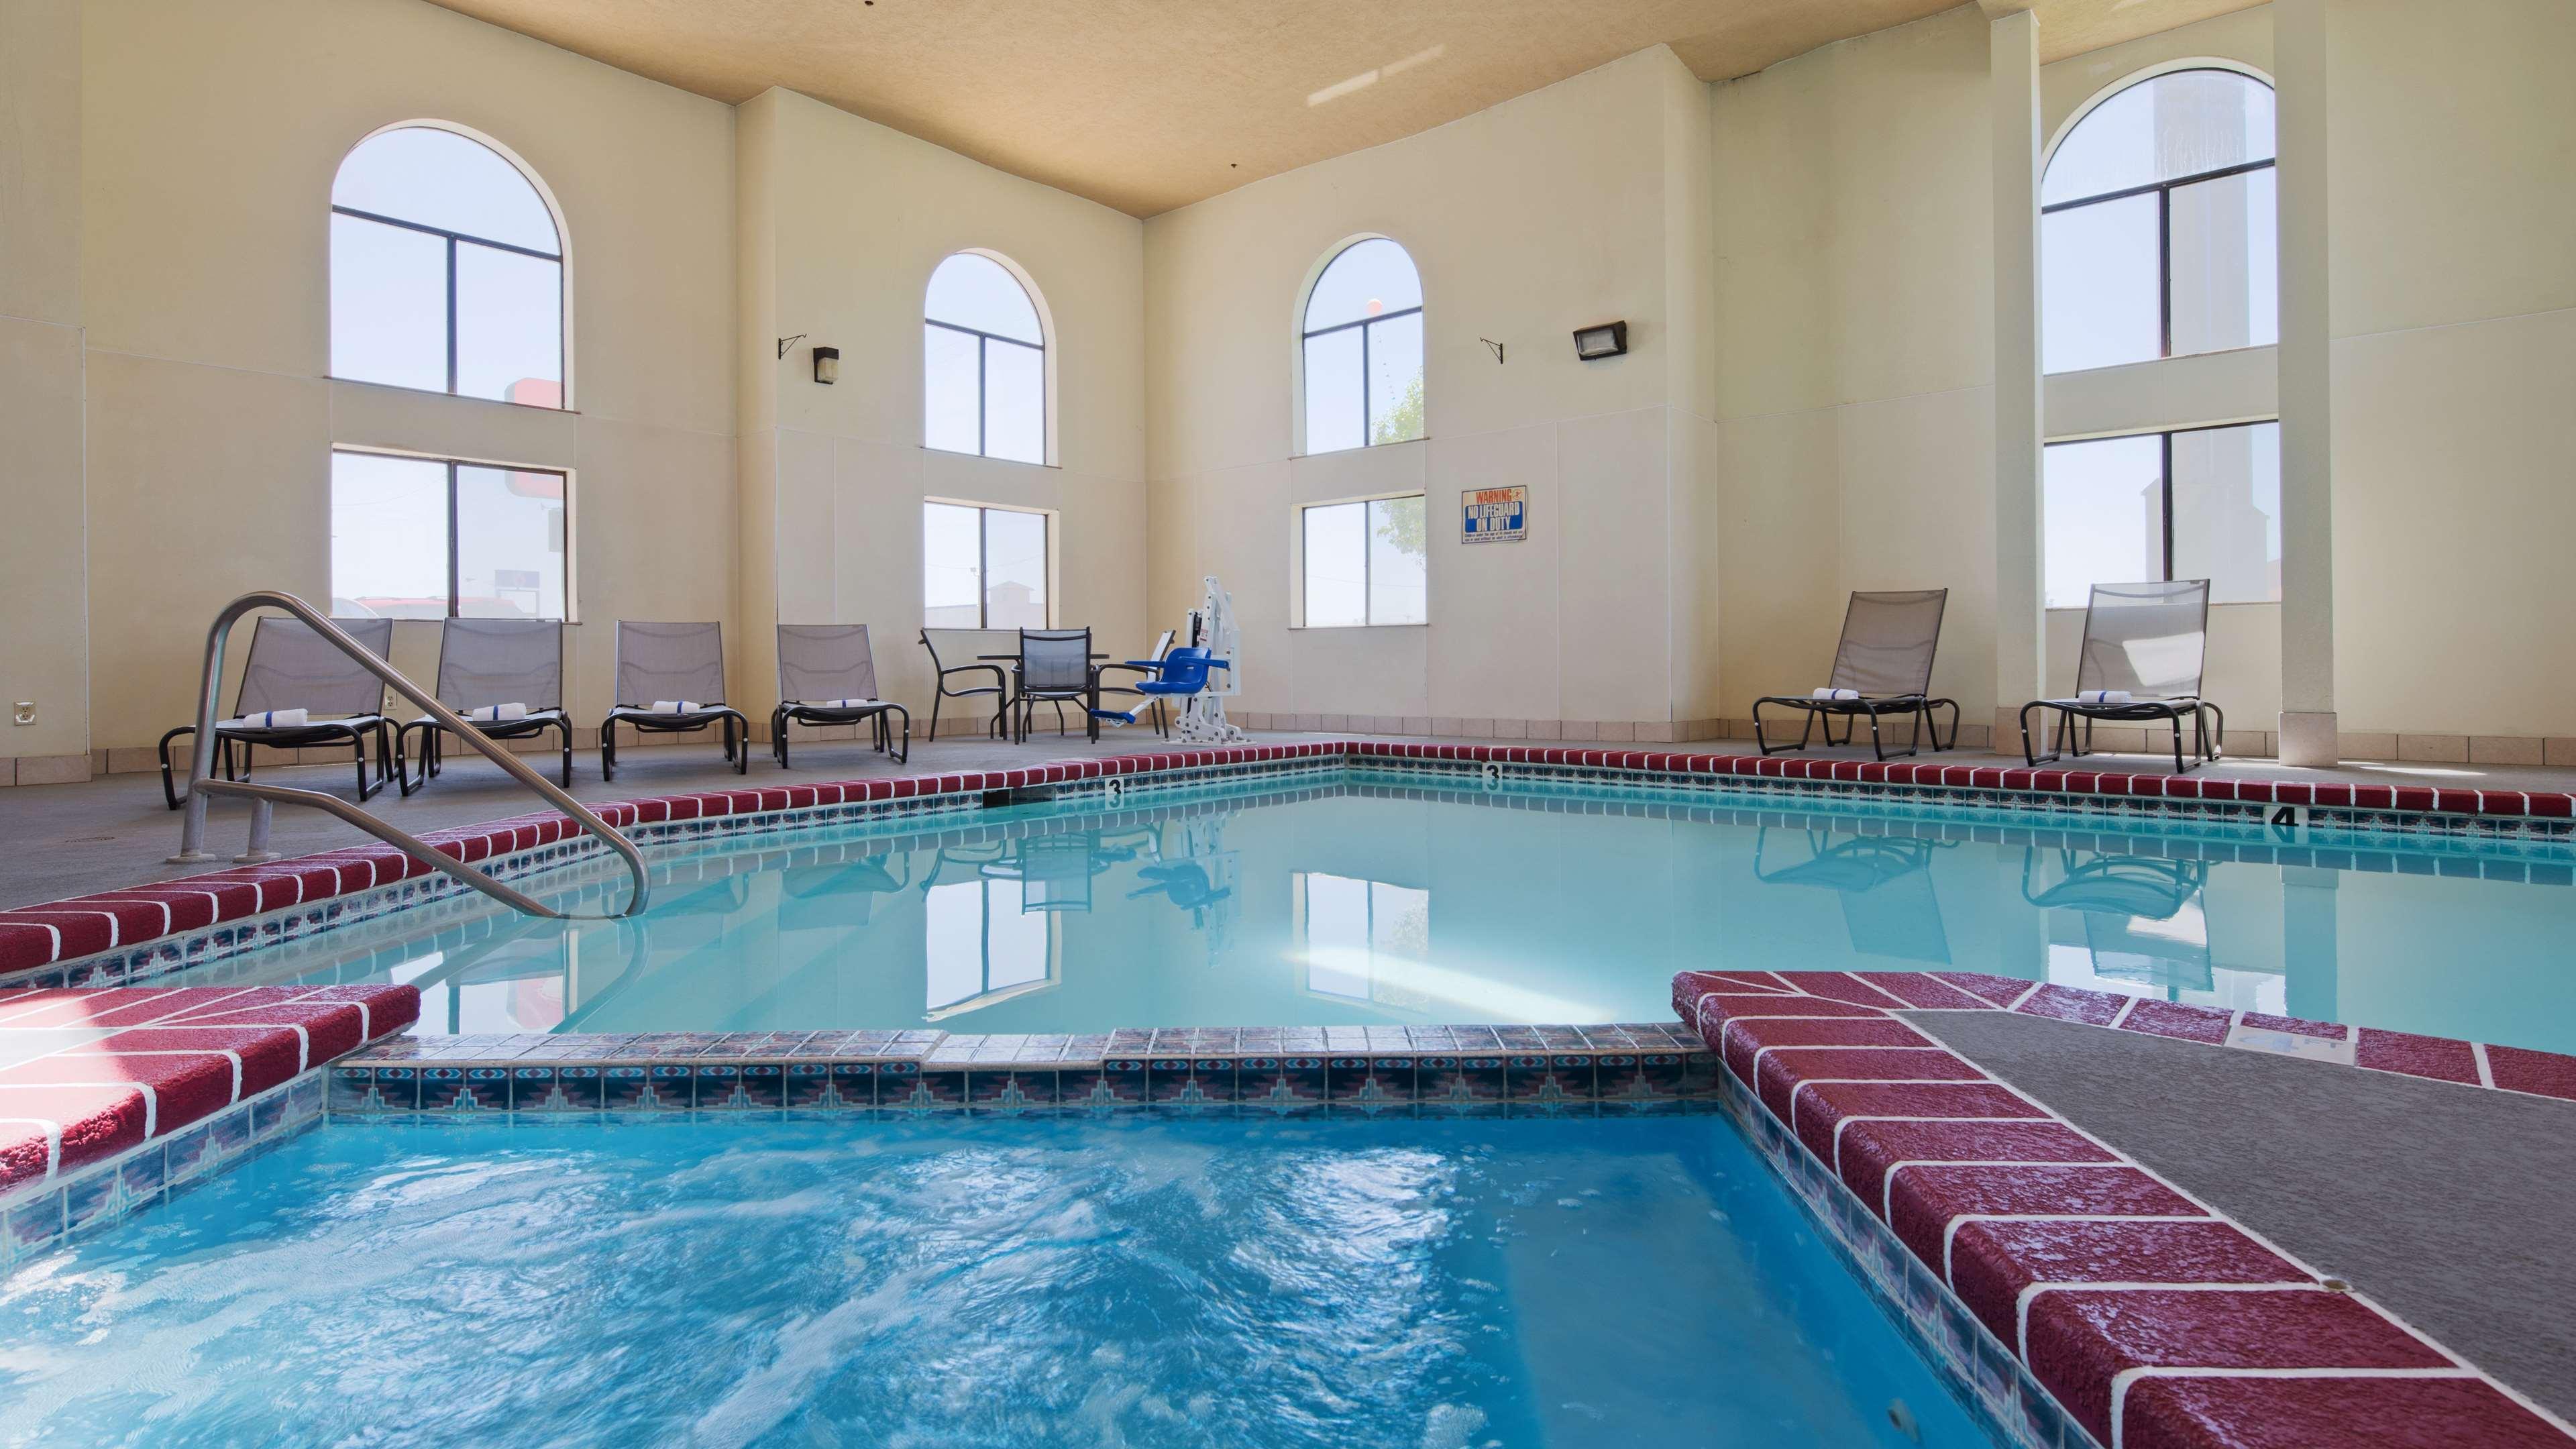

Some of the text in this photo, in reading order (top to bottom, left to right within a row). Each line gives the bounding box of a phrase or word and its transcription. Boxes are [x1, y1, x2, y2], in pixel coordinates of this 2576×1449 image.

[1476, 489, 1511, 504] WARNING
[1468, 502, 1519, 519] NO LIFEGUARD
[1477, 517, 1511, 532] ON DUTY
[1487, 765, 1499, 779] 3
[1109, 779, 1121, 794] 3
[2271, 807, 2299, 826] 4
